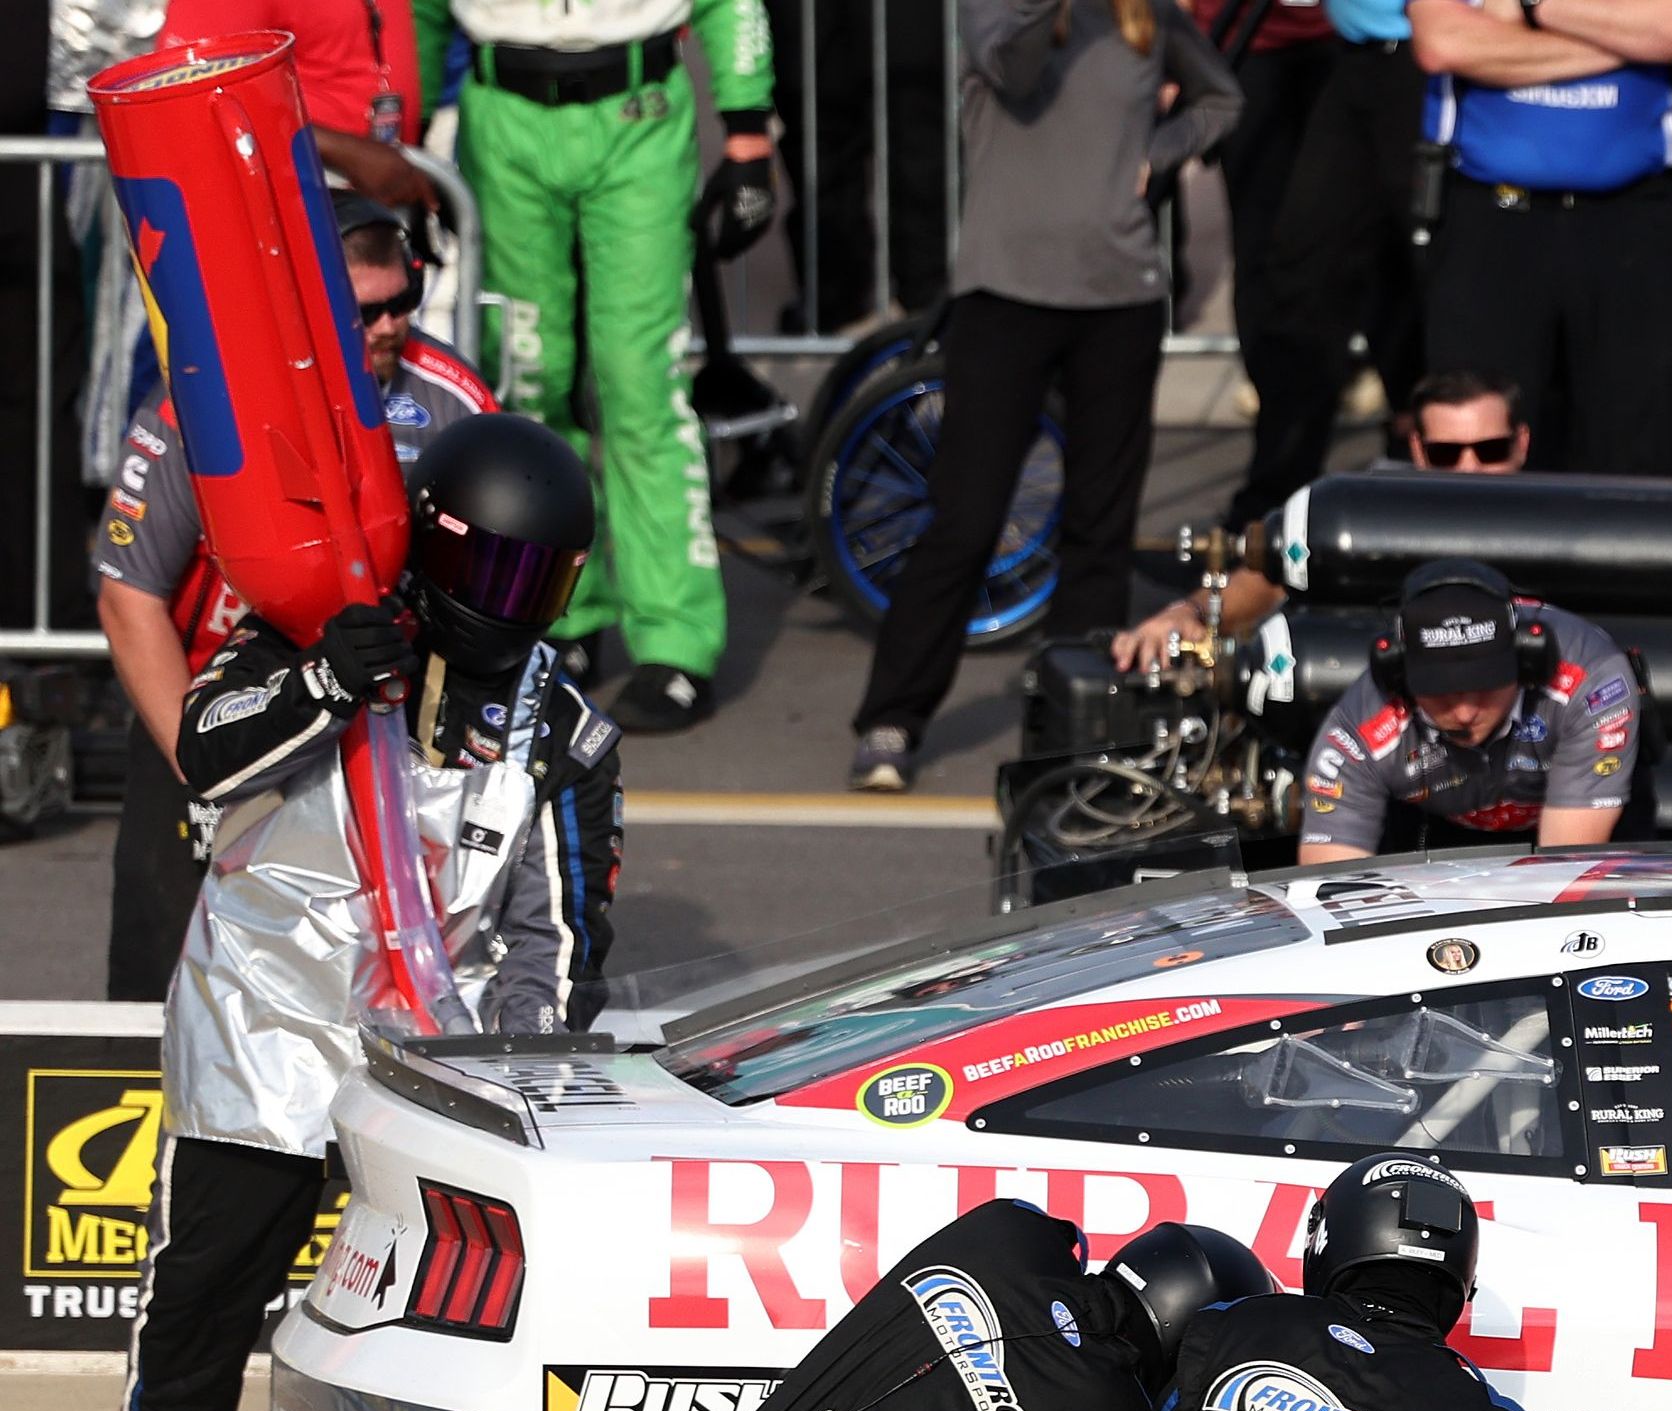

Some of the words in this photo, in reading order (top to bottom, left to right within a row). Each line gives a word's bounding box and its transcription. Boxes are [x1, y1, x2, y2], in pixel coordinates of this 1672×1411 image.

[1588, 979, 1638, 998] Ford
[963, 999, 1223, 1083] BEEFAROOFRANCHISE.COM
[1585, 1025, 1654, 1039] Millertech
[1602, 1065, 1660, 1074] SUPERIOR
[1602, 1073, 1643, 1082] ESSEX
[878, 1072, 934, 1096] BEEF
[883, 1095, 926, 1118] ROO
[1591, 1108, 1633, 1121] RURAL
[1634, 1107, 1665, 1120] KING
[24, 1285, 139, 1319] TRUS
[1332, 1326, 1370, 1352] Ford
